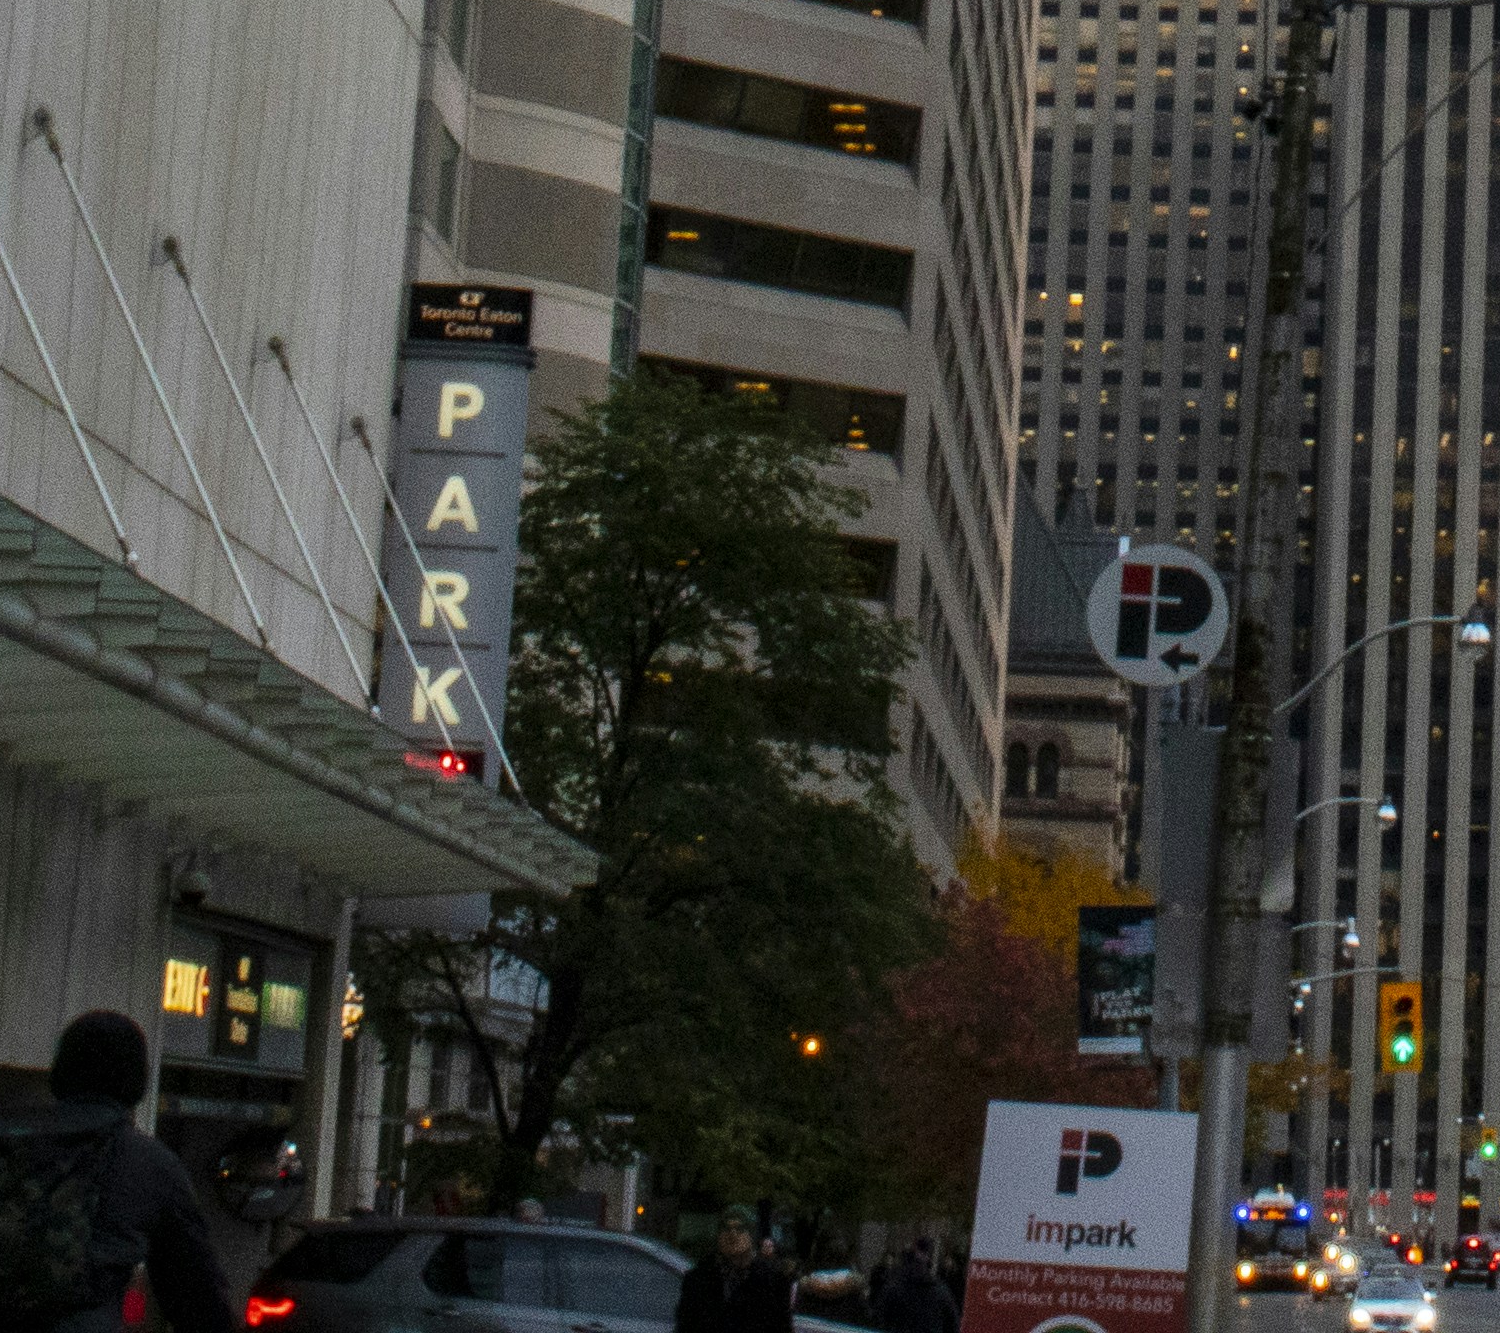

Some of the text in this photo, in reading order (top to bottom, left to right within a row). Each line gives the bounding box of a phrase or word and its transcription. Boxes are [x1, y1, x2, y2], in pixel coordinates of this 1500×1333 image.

[420, 305, 523, 324] Toronto Eaton
[444, 321, 494, 339] Centre
[411, 382, 485, 725] PARK
[1025, 1213, 1137, 1251] impark
[970, 1263, 1037, 1285] Monthly
[1042, 1270, 1105, 1291] Parking
[986, 1286, 1053, 1307] Contact
